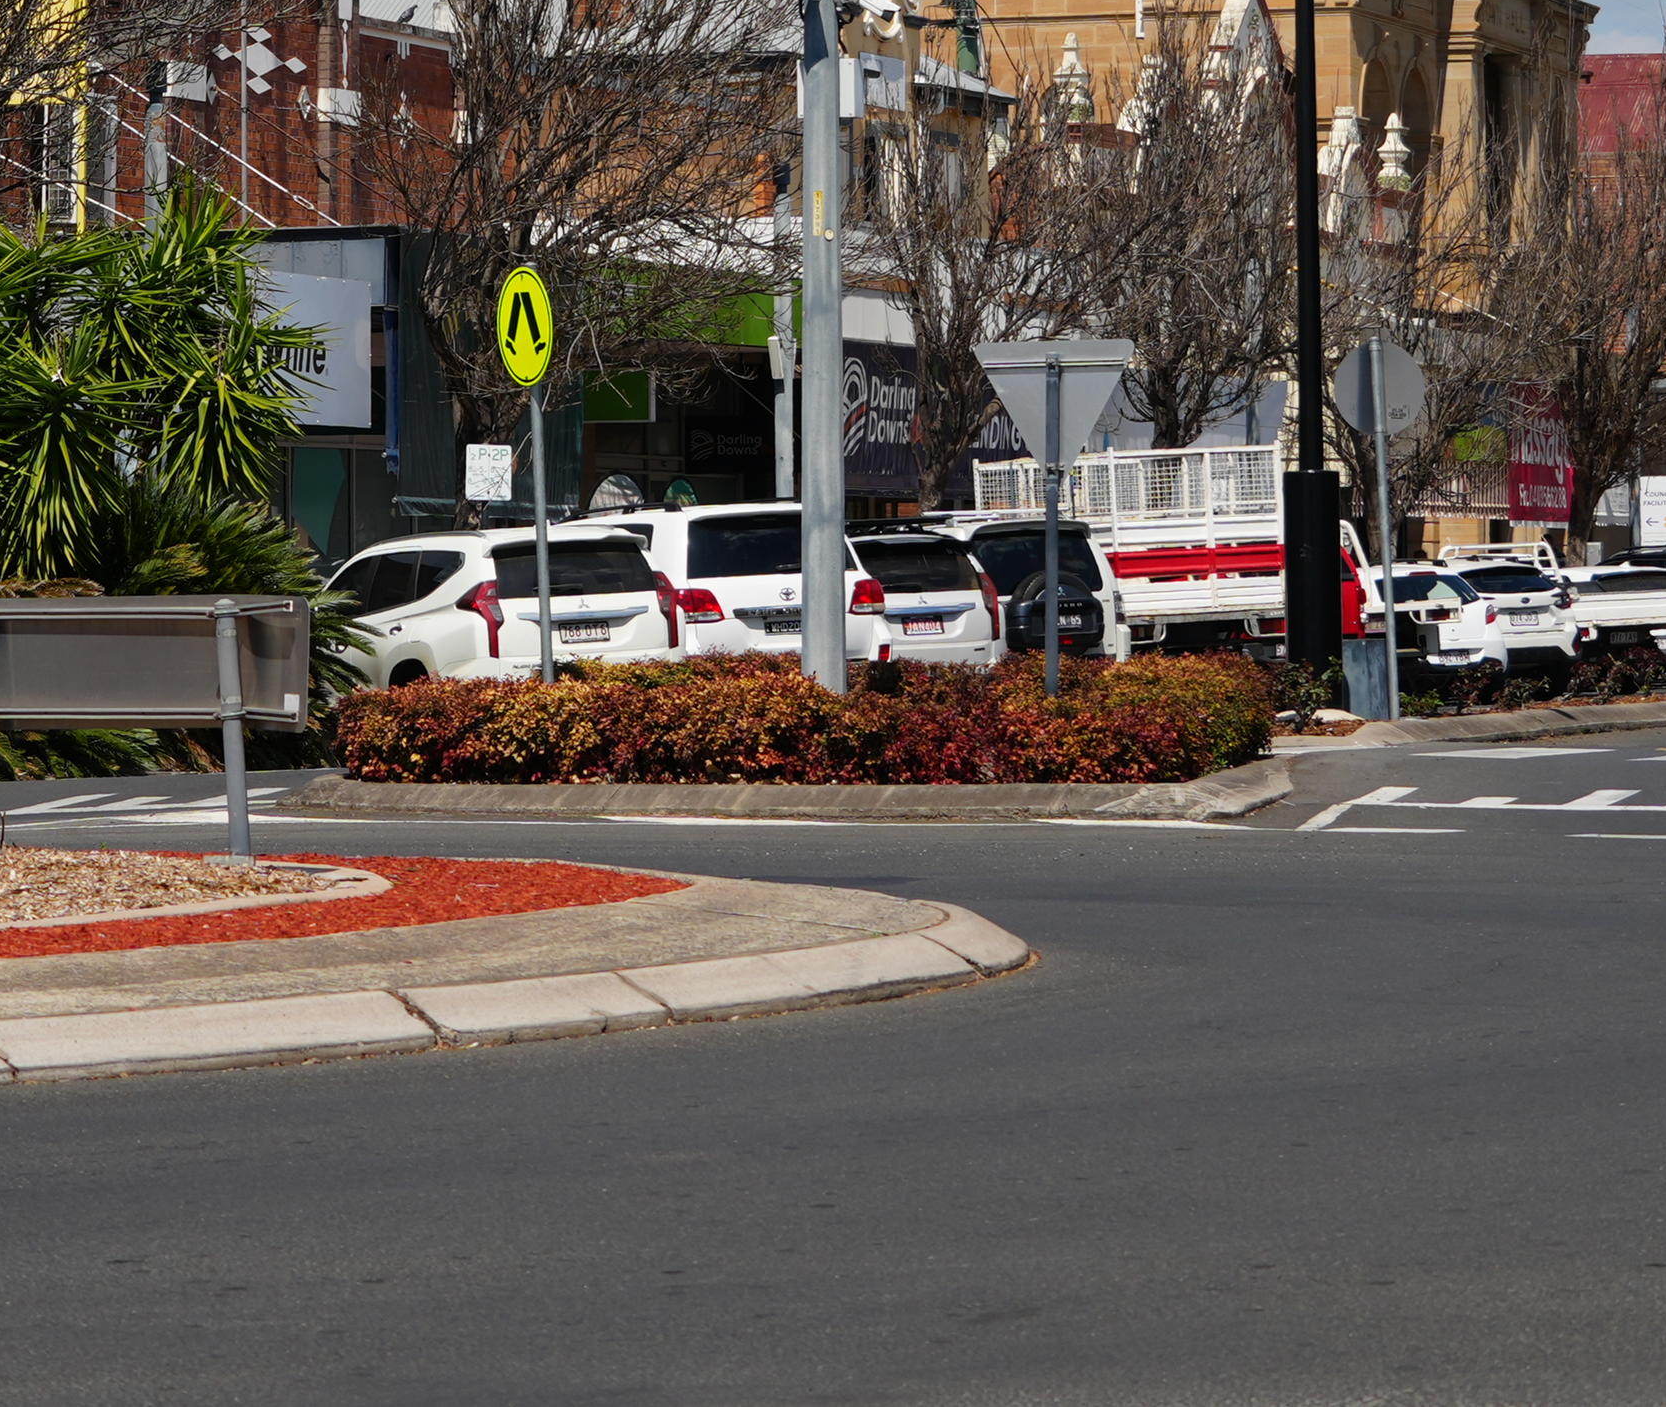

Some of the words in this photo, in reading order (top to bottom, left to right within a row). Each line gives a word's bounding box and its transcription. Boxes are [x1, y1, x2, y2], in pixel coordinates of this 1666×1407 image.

[870, 375, 917, 419] Darling
[867, 410, 912, 445] Downs
[717, 433, 762, 450] Darling
[717, 445, 758, 456] Downs
[770, 621, 801, 631] WHD20
